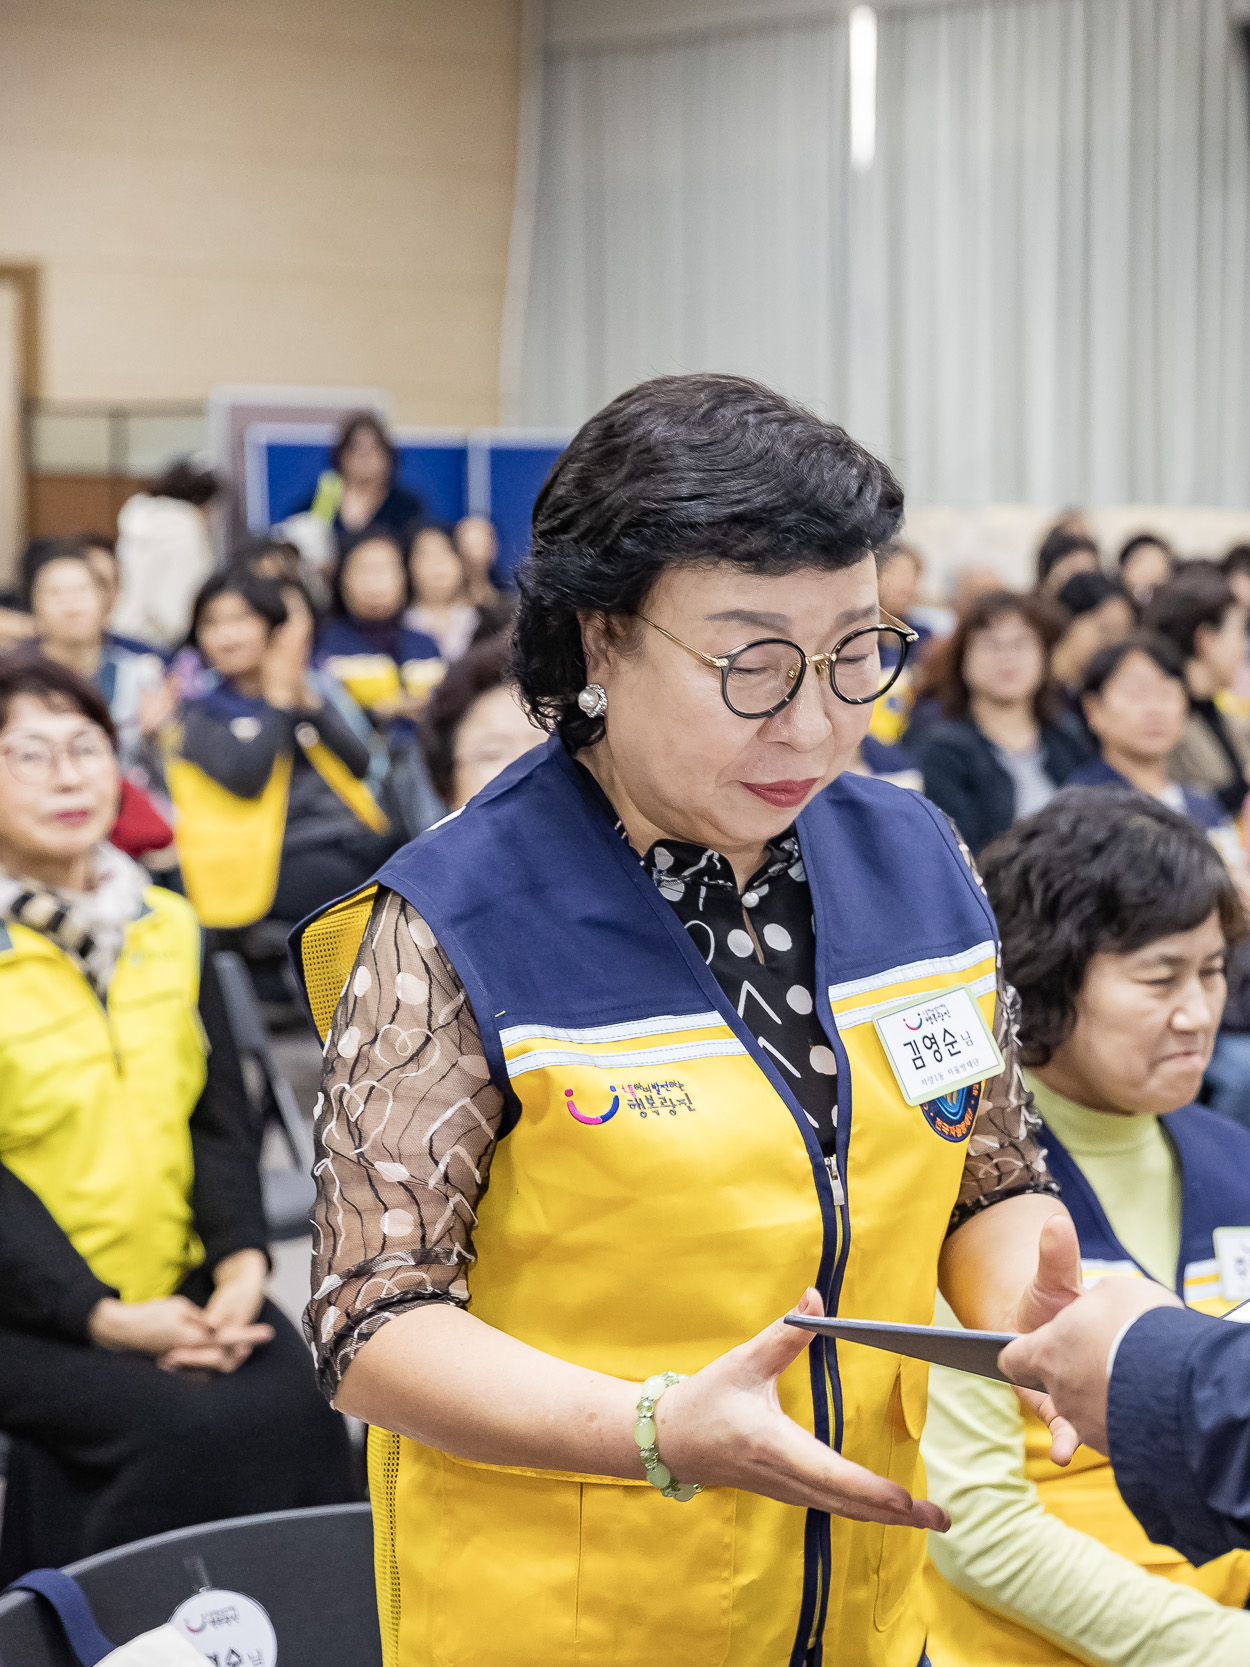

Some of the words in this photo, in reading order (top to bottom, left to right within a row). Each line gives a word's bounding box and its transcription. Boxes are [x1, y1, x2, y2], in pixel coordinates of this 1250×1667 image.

[903, 1028, 962, 1070] 김영순
[961, 1030, 975, 1047] 님
[627, 1091, 696, 1118] 행복광진
